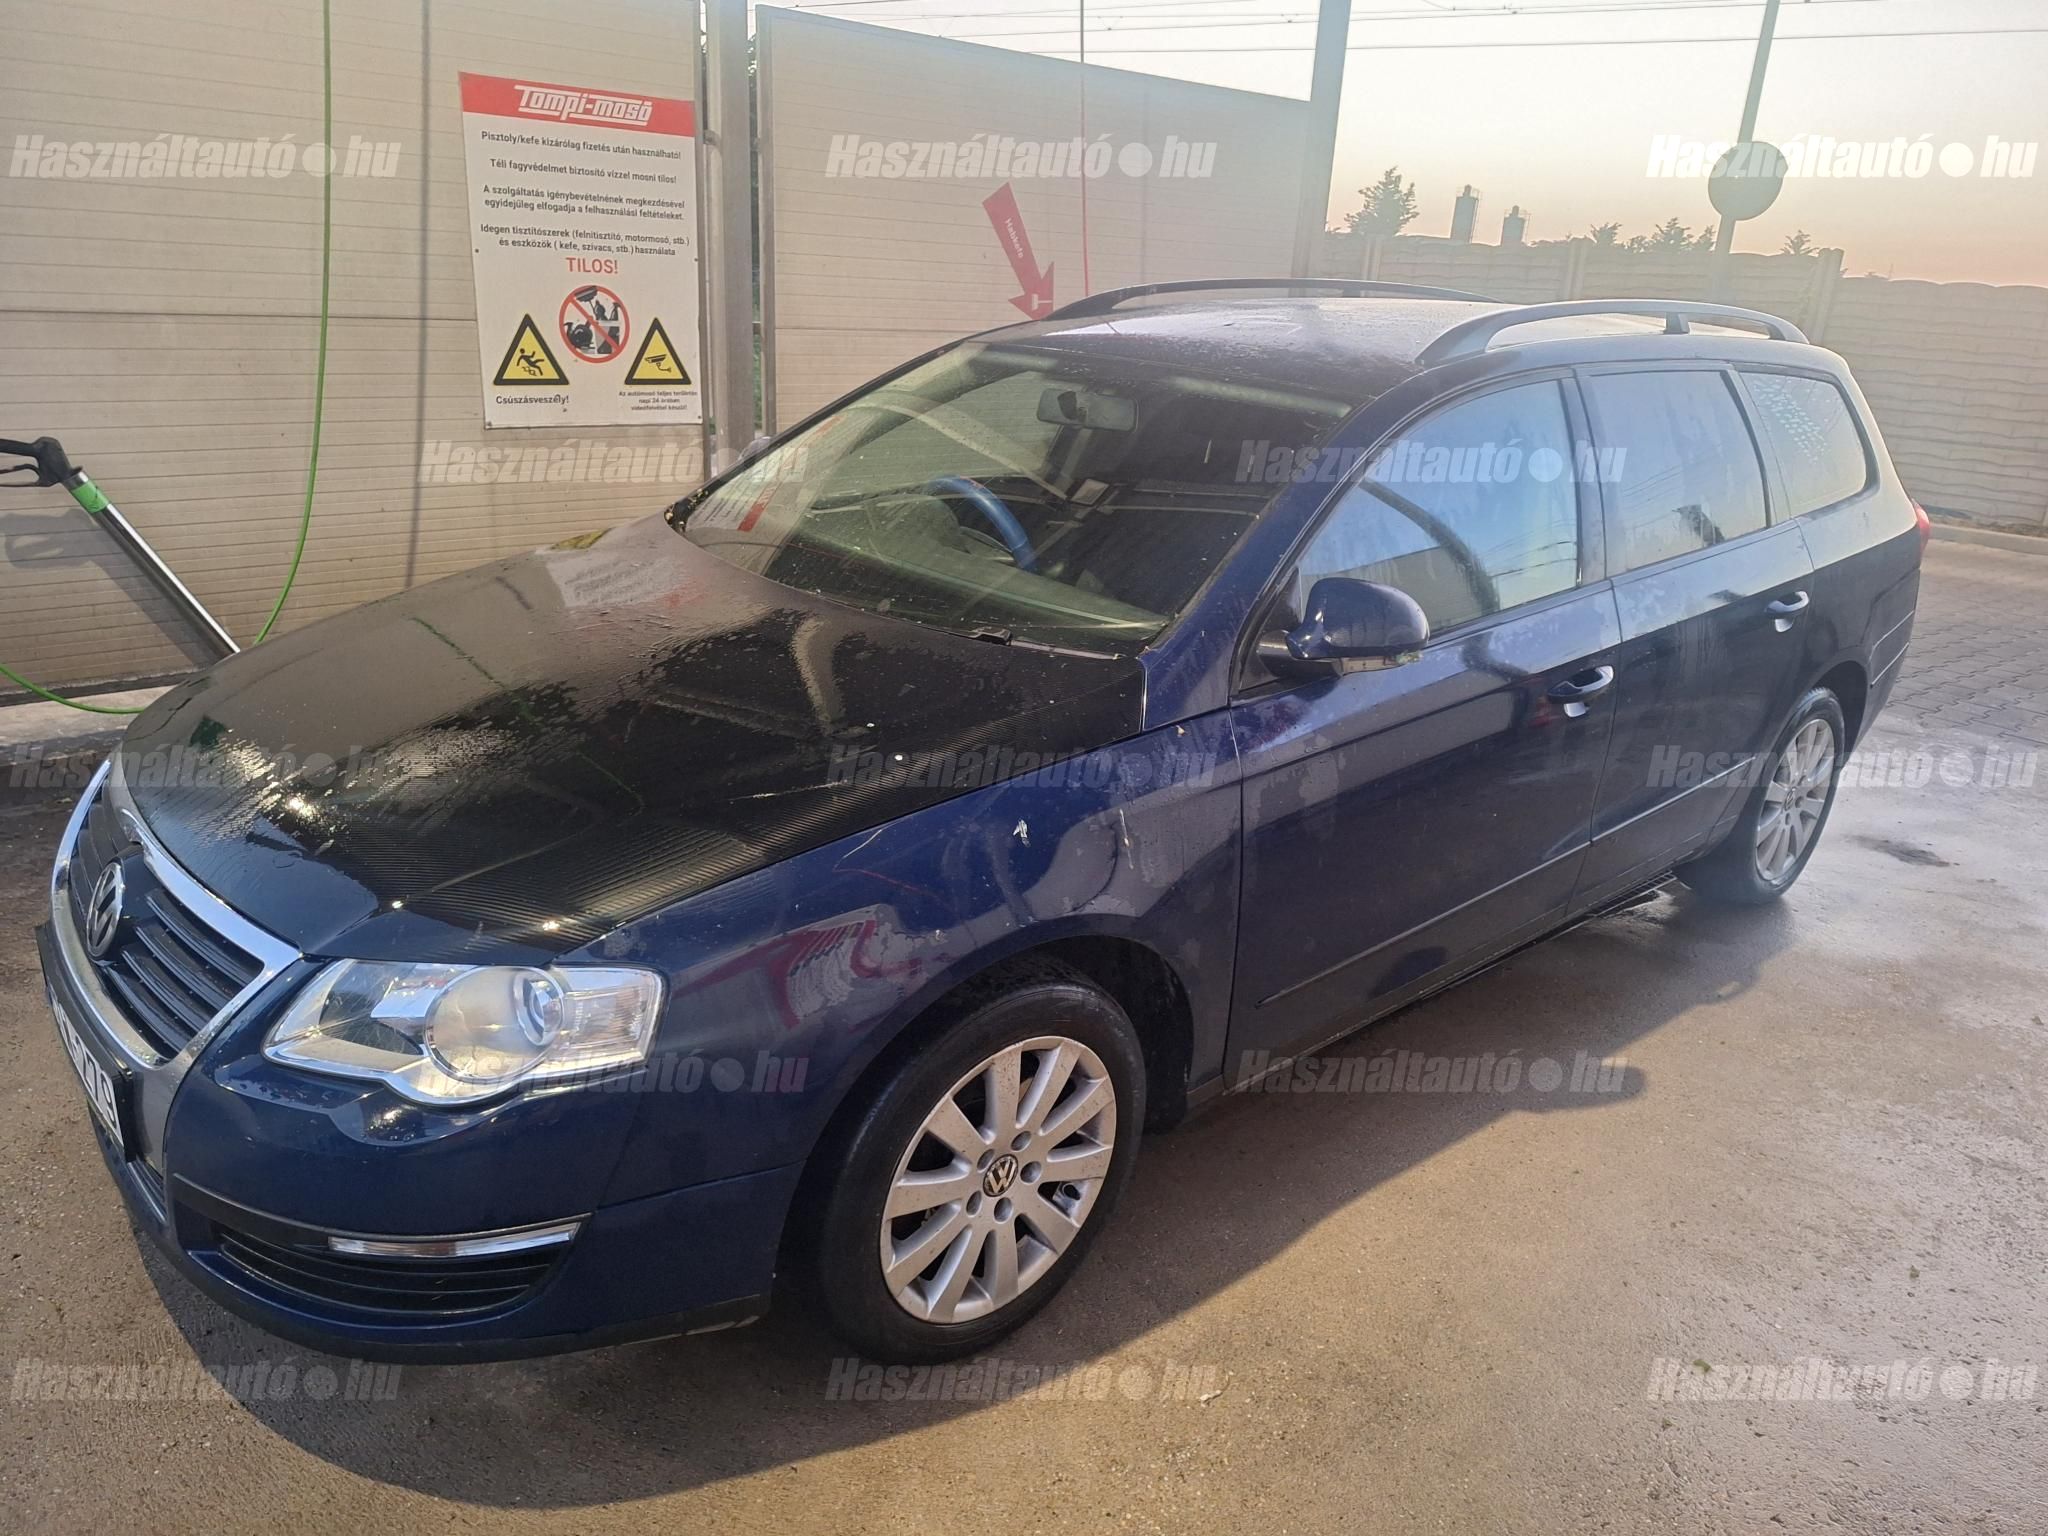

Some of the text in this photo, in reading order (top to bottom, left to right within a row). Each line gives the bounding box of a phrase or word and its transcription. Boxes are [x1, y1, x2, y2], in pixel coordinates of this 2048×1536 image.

[481, 131, 681, 160] Pisztoly/kefe kizárólag fizetés után használható!
[490, 159, 677, 184] Téli fagyvédelmet biztosító vízzel mosni tilos!
[483, 185, 490, 193] A
[492, 186, 545, 197] szolgáltatás
[625, 197, 685, 209] megkezdésével
[484, 198, 535, 211] egyidejűleg
[536, 201, 576, 214] elfogadja
[585, 205, 638, 217] felhasználási
[639, 210, 685, 220] feltételeket.
[480, 224, 510, 235] Idegen
[512, 226, 570, 237] tisztítószerek
[625, 234, 672, 245] motormosó,
[673, 236, 690, 247] stb.)
[499, 237, 510, 246] és
[511, 239, 552, 248] eszközök
[559, 241, 580, 251] kefe,
[566, 257, 618, 274] TILOS!
[496, 393, 569, 405] Csúszásveszély!
